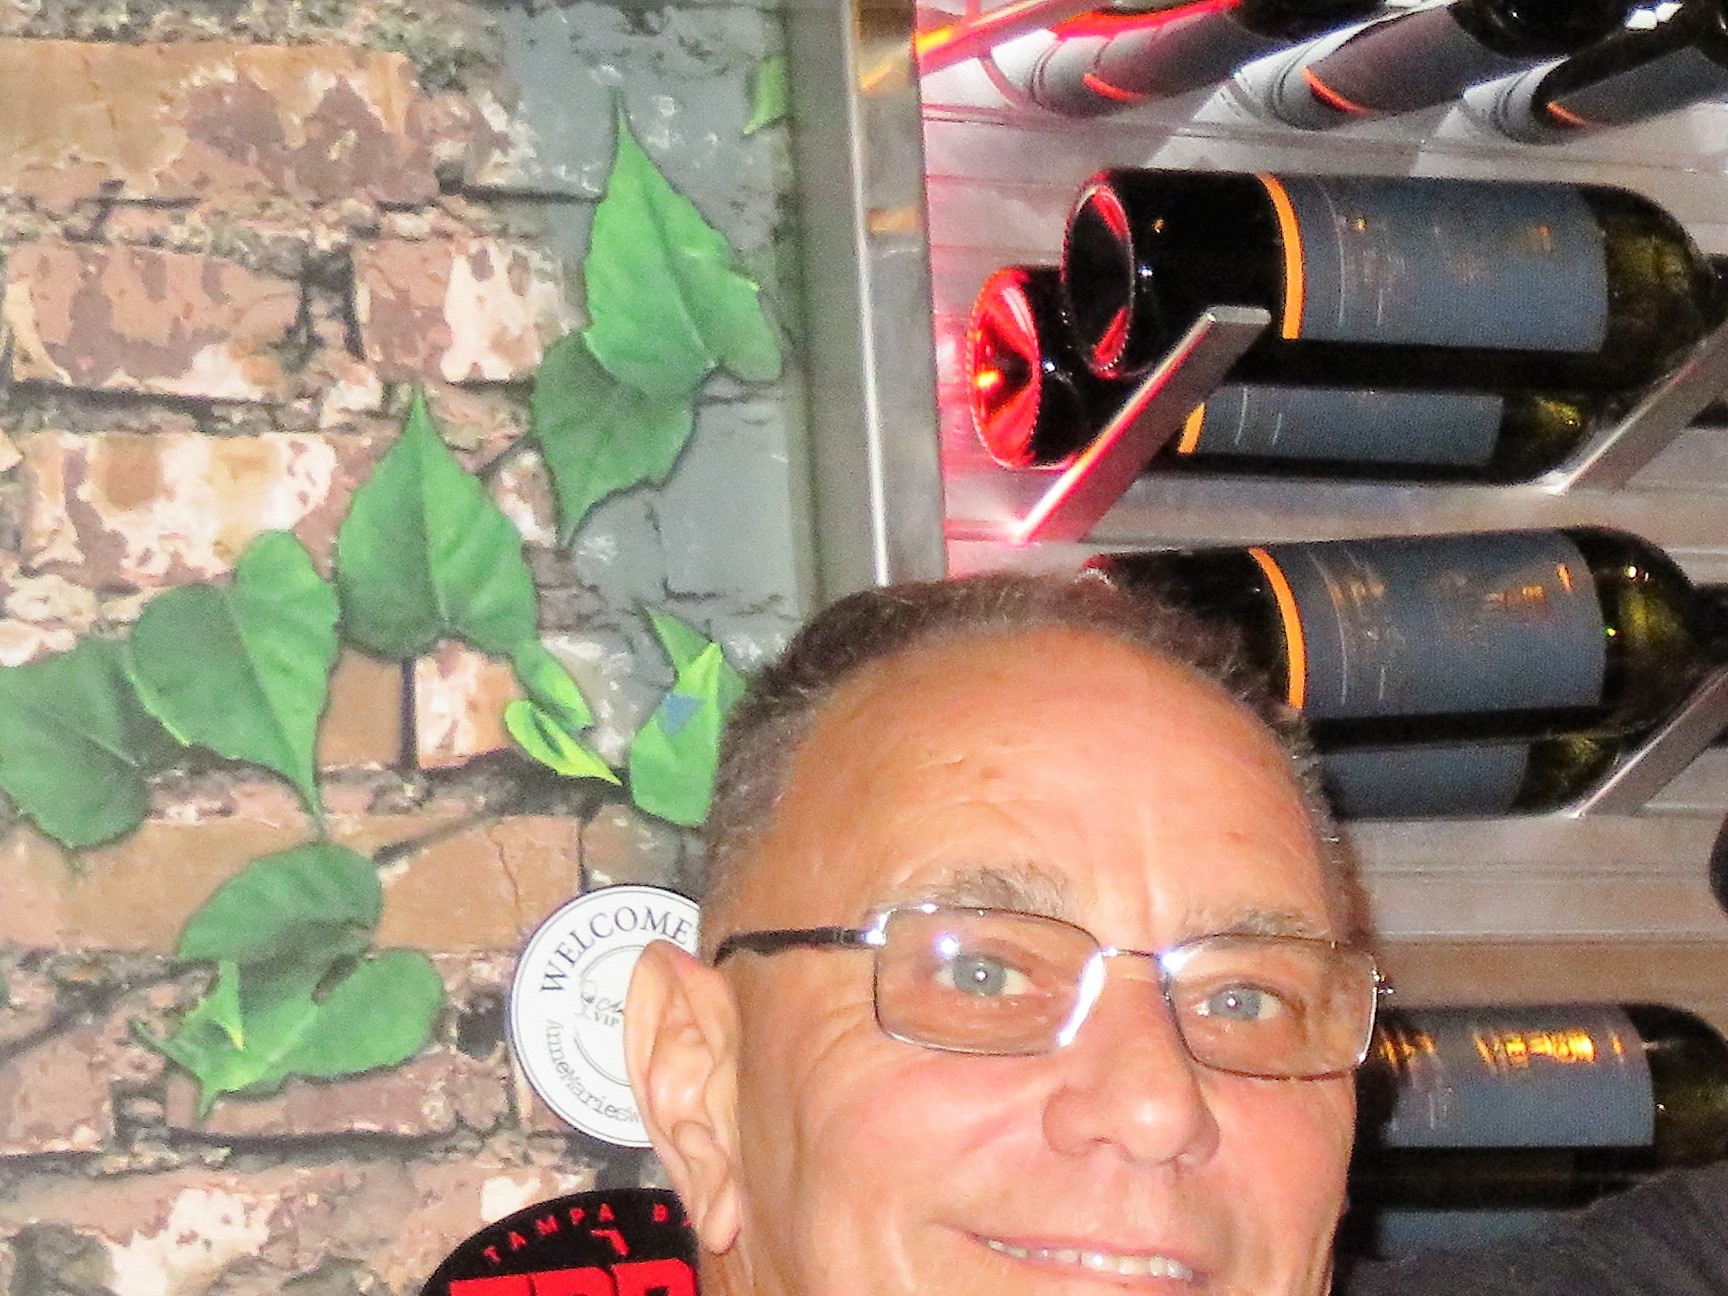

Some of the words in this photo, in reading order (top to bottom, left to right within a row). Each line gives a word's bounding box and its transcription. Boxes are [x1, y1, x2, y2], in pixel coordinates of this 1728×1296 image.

[540, 906, 693, 993] WELCOME
[594, 1011, 620, 1028] VIP
[483, 1203, 616, 1263] TAMPA
[653, 1203, 693, 1228] B
